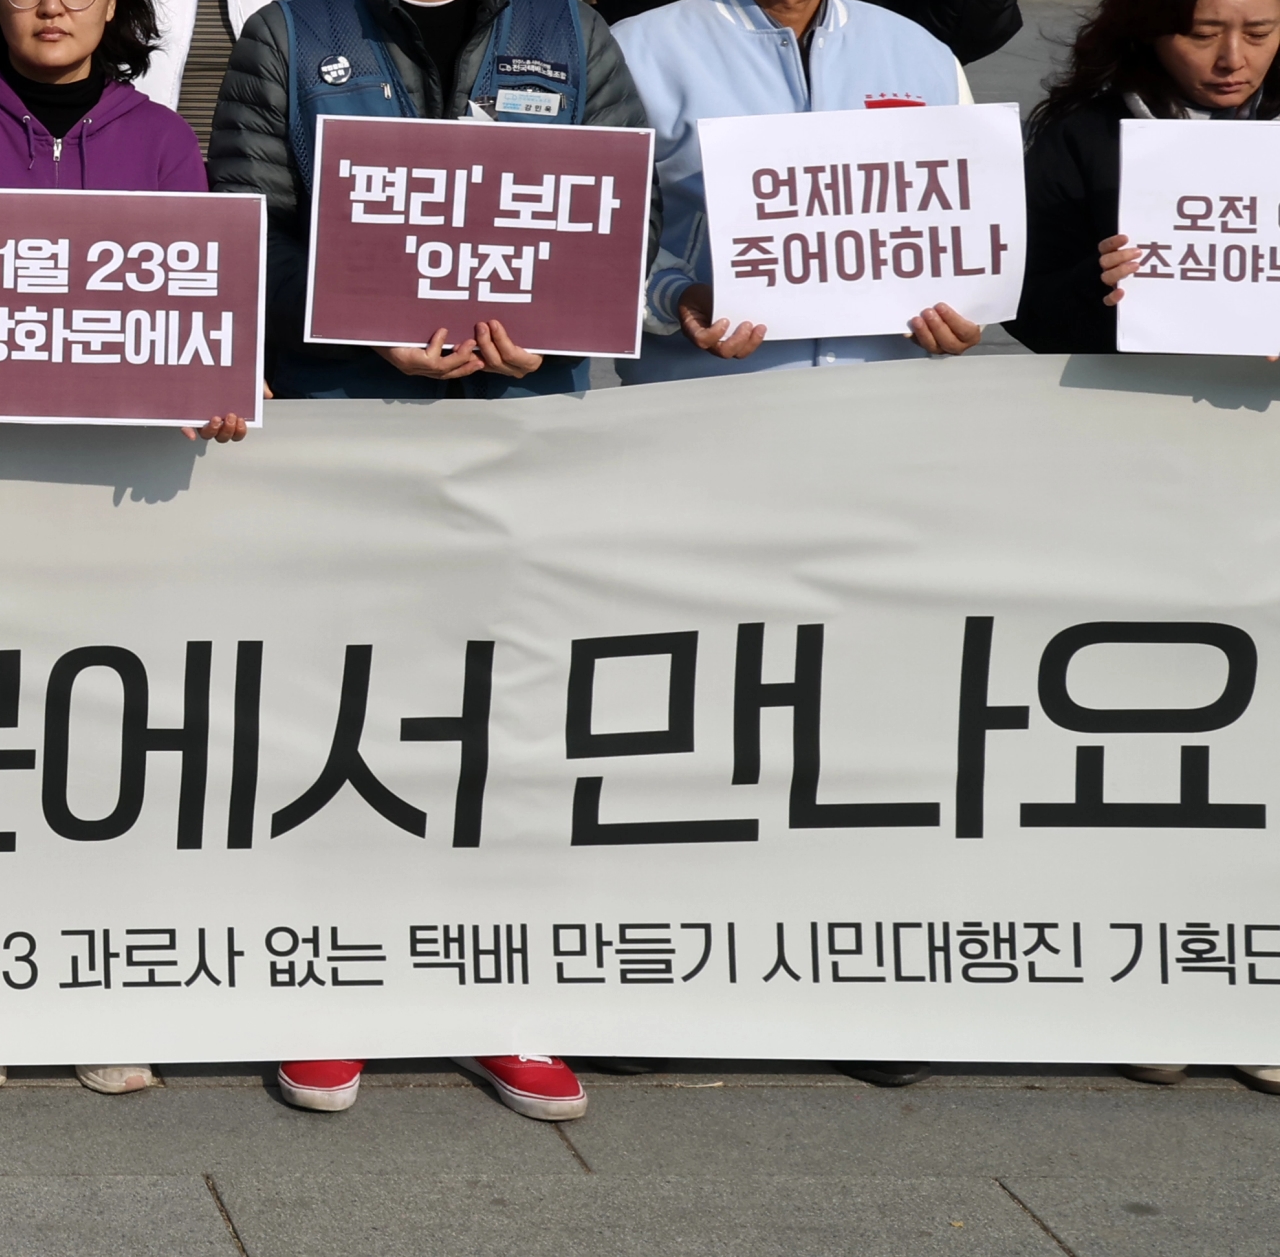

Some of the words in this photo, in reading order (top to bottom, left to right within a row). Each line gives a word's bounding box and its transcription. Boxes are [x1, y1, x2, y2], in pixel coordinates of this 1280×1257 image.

[512, 64, 567, 80] 전국택배노동조합
[338, 159, 483, 228] '편리'
[493, 172, 621, 235] 보다
[751, 158, 971, 221] 언제까지
[1173, 195, 1258, 234] 오전
[85, 240, 219, 297] 23일
[405, 235, 551, 303] '안전'
[730, 224, 1008, 288] 죽어야하나
[59, 927, 244, 989] 과로사
[265, 926, 386, 987] 없는
[410, 924, 529, 985] 택배
[553, 922, 736, 984] 만들기
[763, 922, 1083, 983] 시민대행진
